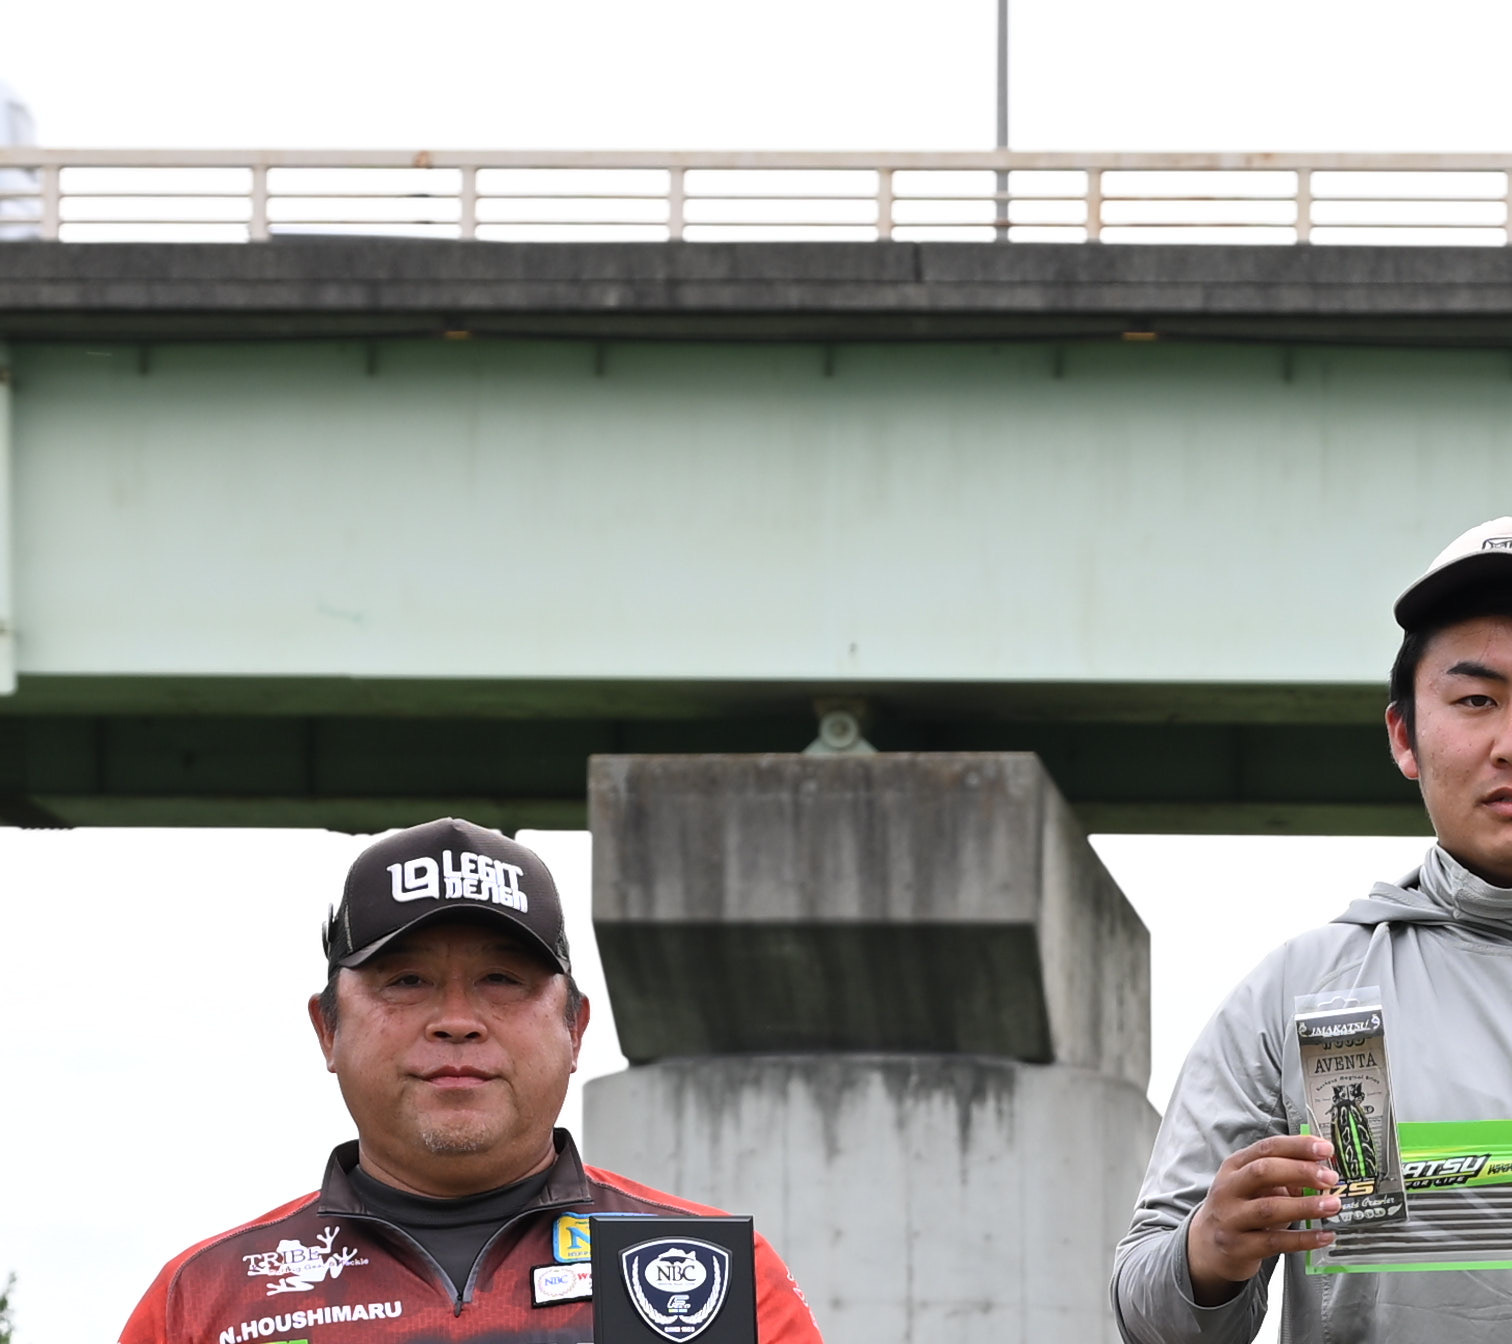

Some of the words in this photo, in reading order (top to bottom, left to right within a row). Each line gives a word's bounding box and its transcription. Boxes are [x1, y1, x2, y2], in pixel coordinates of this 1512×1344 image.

[442, 850, 524, 891] LEGIT
[444, 877, 528, 913] DESIGN
[1314, 1052, 1378, 1074] AVENTA
[1401, 1153, 1490, 1178] ATSU
[243, 1248, 322, 1272] TRIBE
[656, 1265, 697, 1282] NBC
